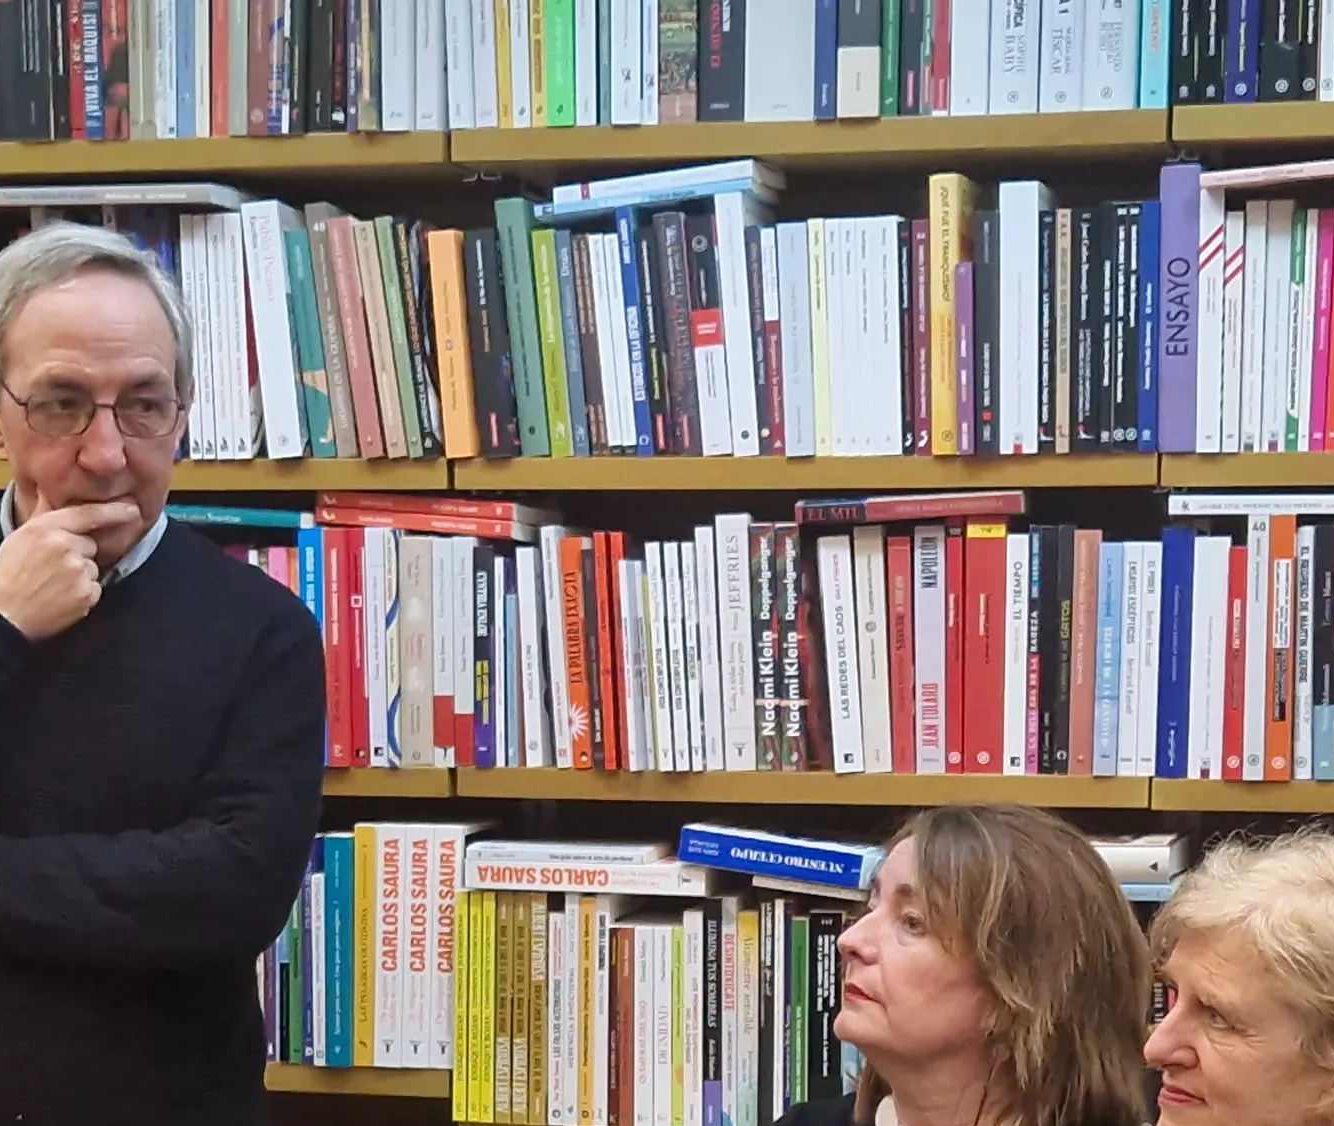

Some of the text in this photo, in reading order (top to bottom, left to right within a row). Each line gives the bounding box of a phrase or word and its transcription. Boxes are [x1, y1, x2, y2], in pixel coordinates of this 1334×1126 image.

[84, 66, 98, 80] EL
[1003, 35, 1015, 74] BABY
[85, 85, 102, 116] ¡VIVA
[259, 214, 276, 302] Pablo Picasso
[1167, 257, 1190, 356] ENSAYO
[918, 537, 938, 589] NAPOLEÓN
[1251, 522, 1266, 532] 40
[726, 535, 745, 611] JEFFRIES
[758, 537, 772, 620] Doppelganger
[783, 537, 797, 620] Doppelganger
[1012, 562, 1023, 620] EL TIEMPO
[563, 571, 584, 685] LA PALABRA EXACTA
[1029, 611, 1038, 652] RAREZA
[1060, 600, 1070, 639] GATOS
[759, 631, 775, 736] Naomi Klein
[783, 631, 800, 737] Naomi Klein
[834, 605, 851, 720] LAS REDES DEL CAOS
[920, 683, 938, 749] JEAN TULARD
[383, 839, 399, 899] SAURA
[476, 865, 609, 887] CARLOS SAURA
[729, 846, 845, 875] NUESTRO CUERPO
[382, 902, 397, 972] CARLOS
[409, 839, 428, 972] CARLOS SAURA
[437, 840, 456, 974] CARLOS SAURA
[707, 920, 717, 1028] ILUMINA TUS SOMBRAS
[742, 936, 753, 1036] Altamente sensible
